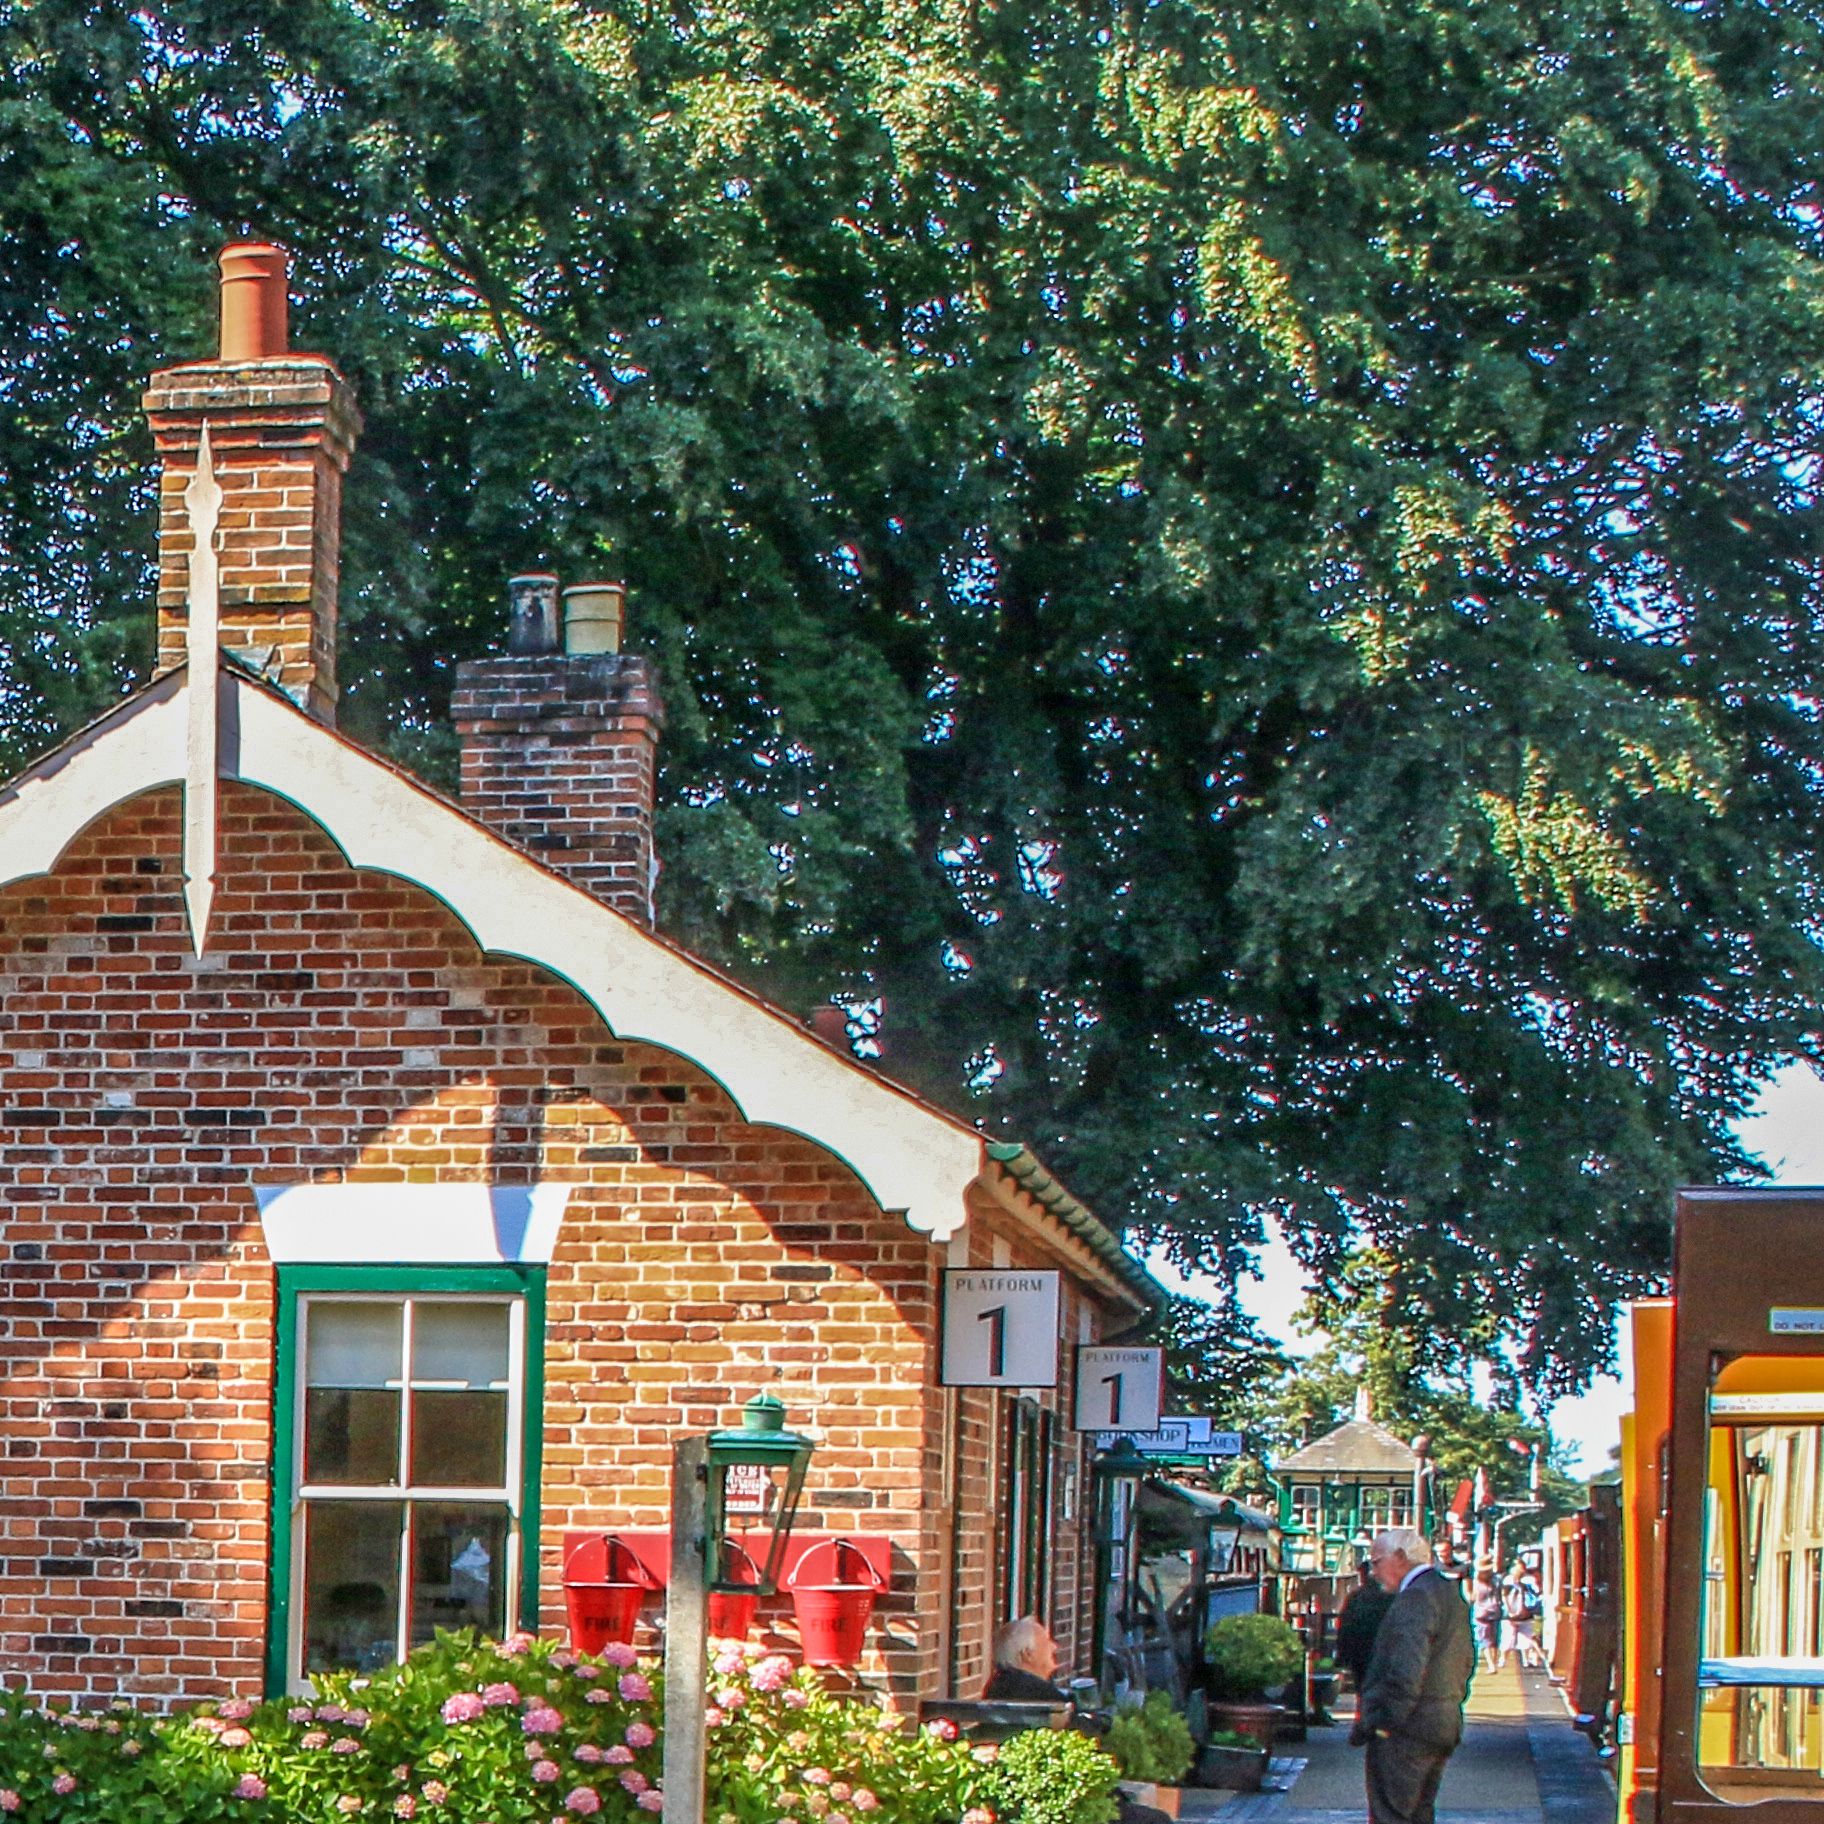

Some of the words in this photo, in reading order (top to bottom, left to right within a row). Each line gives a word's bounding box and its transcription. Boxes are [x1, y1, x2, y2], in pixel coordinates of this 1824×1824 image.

[955, 1278, 1042, 1292] PLATFORM
[977, 1304, 1006, 1377] 1
[1085, 1352, 1150, 1363] PLATFORM
[1101, 1372, 1123, 1425] 1
[584, 1615, 620, 1632] FIRE
[811, 1616, 848, 1633] FIRE
